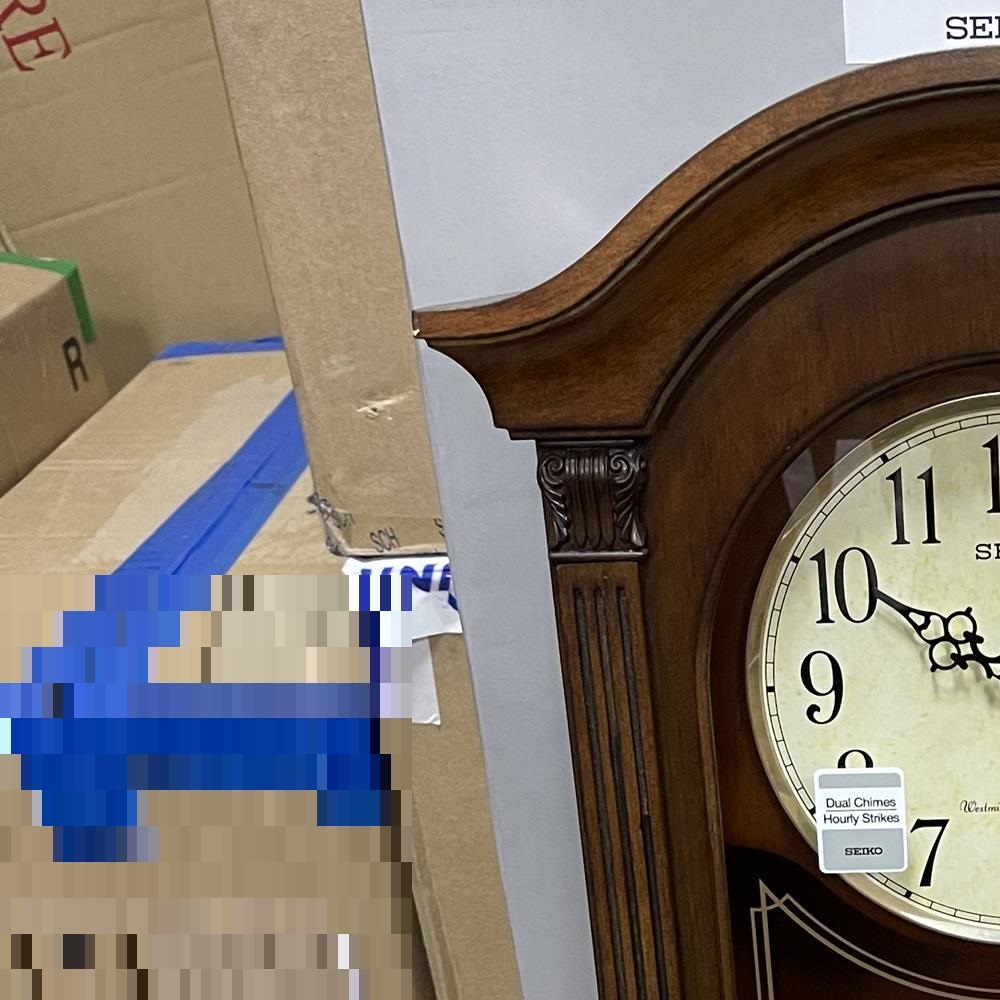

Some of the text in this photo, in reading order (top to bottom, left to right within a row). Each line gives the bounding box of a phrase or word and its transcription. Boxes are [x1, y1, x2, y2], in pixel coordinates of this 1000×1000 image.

[886, 466, 941, 545] 11
[370, 527, 402, 553] SCH
[810, 547, 878, 624] 10
[800, 651, 844, 724] 9
[823, 813, 900, 826] Hourly Strikes
[826, 797, 897, 808] Dual Chimes
[845, 847, 883, 856] SEIKO
[910, 818, 949, 887] 7
